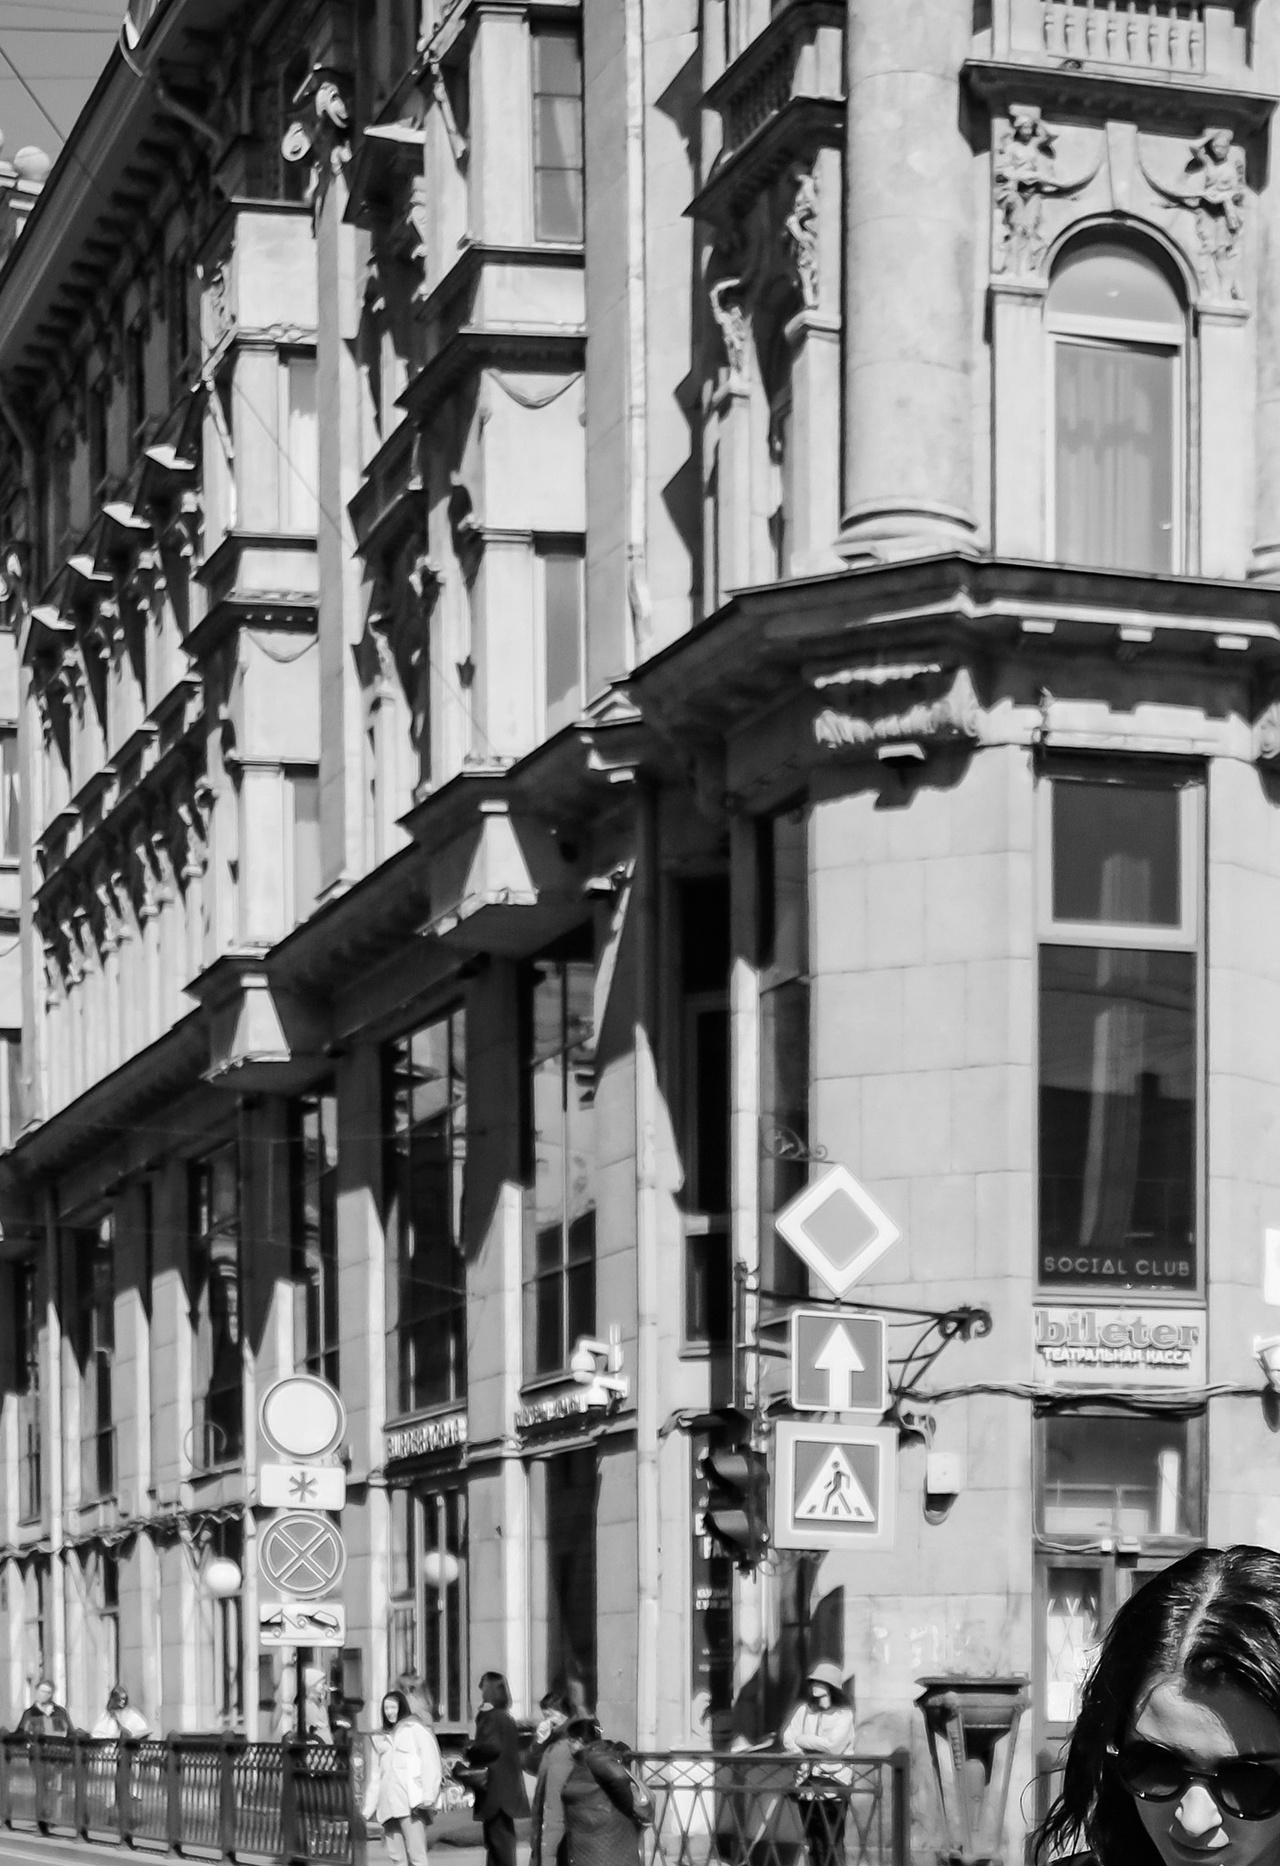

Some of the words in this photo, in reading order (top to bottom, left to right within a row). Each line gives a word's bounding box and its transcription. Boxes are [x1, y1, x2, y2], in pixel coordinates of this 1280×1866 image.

[1043, 1256, 1128, 1275] SOCIAL
[1135, 1259, 1190, 1277] CLUB
[1036, 1310, 1199, 1350] bileter
[1146, 1350, 1192, 1364] КАССА
